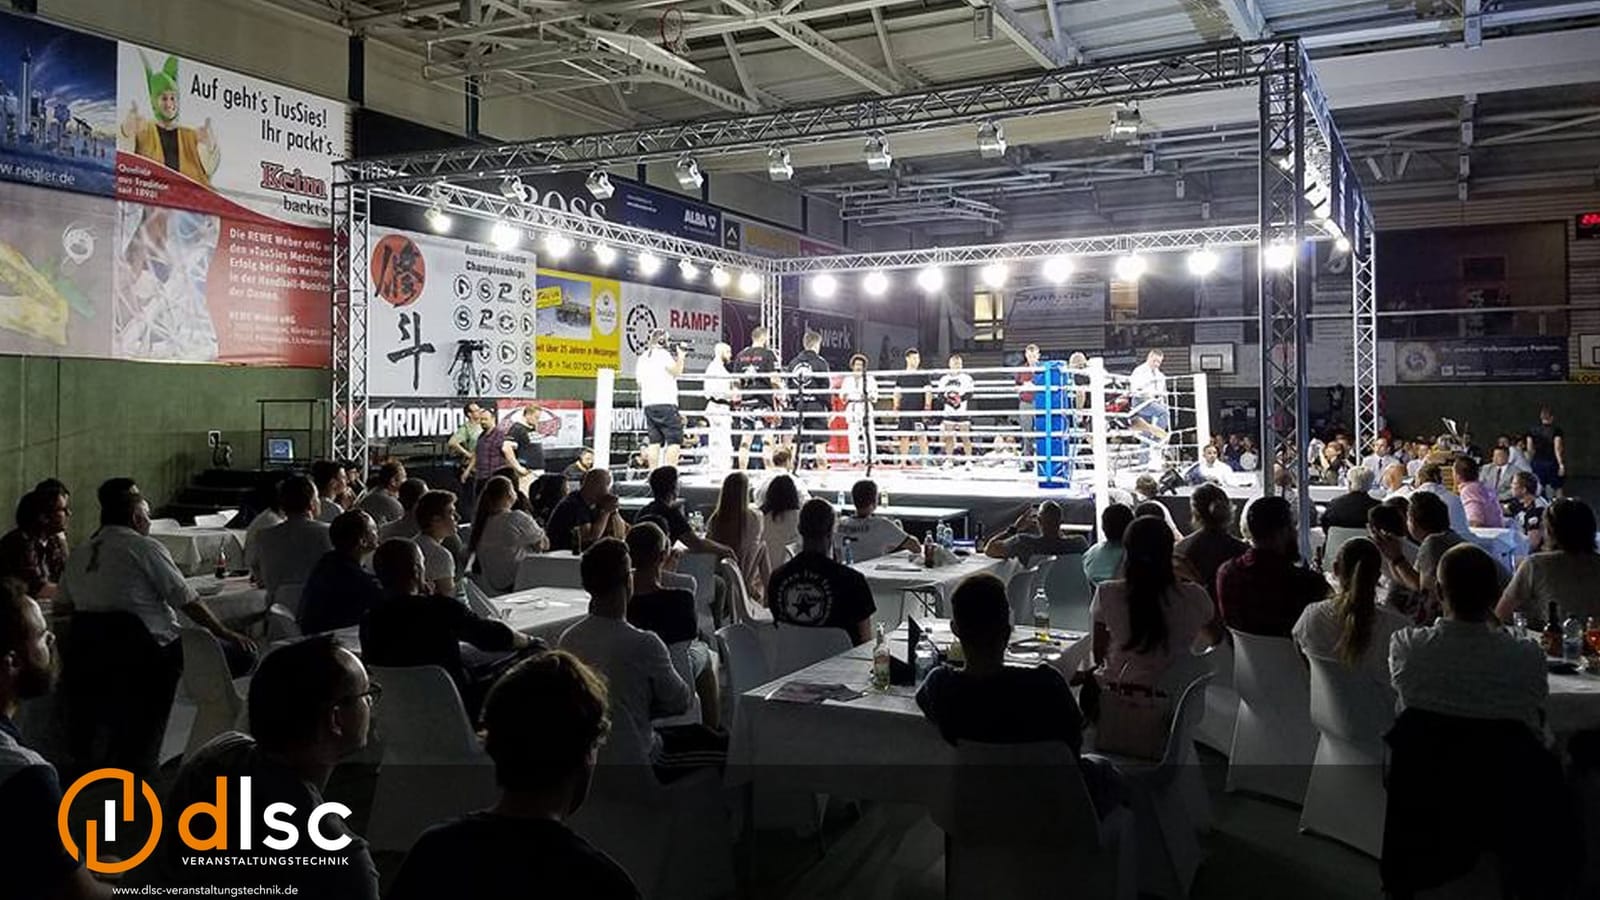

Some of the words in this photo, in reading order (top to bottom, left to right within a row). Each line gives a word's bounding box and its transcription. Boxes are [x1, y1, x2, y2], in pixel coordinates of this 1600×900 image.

[190, 73, 219, 101] Auf
[223, 86, 268, 114] geht's
[273, 95, 327, 129] TusSies!
[261, 119, 282, 144] Ihr
[287, 131, 345, 158] packt's...
[260, 160, 328, 200] Keim
[282, 195, 329, 217] backt's
[684, 209, 708, 227] ALBA
[229, 227, 246, 240] Die
[248, 231, 273, 244] REWE
[671, 309, 719, 332] RAMPF
